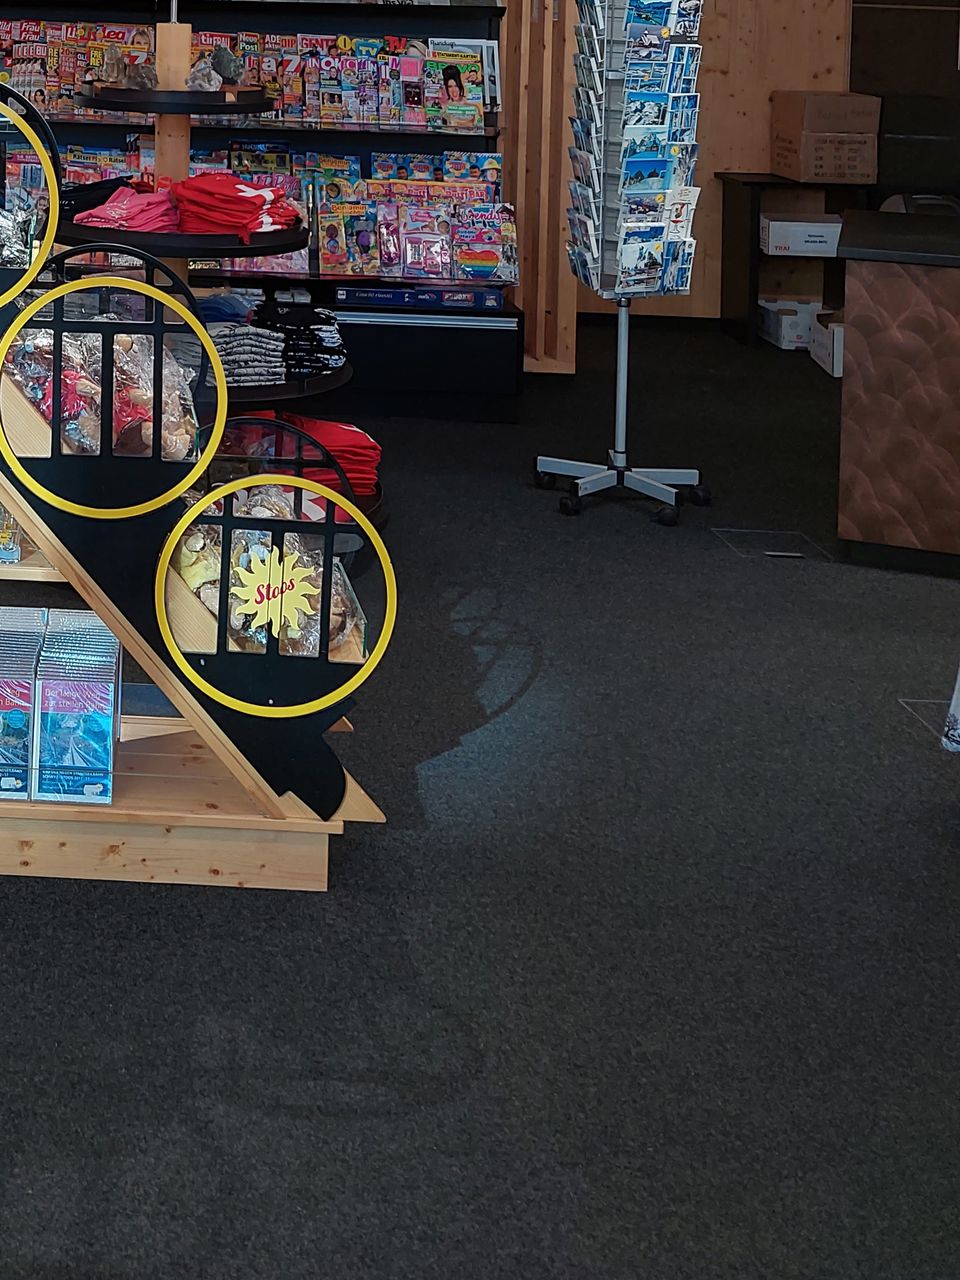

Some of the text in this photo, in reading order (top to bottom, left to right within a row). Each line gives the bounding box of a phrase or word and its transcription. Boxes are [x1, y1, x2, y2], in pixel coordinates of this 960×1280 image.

[21, 22, 40, 32] Frau
[21, 32, 40, 41] Frau
[240, 42, 258, 51] Post
[359, 46, 378, 56] TV
[426, 61, 480, 74] BRVO
[254, 577, 296, 605] Stoos
